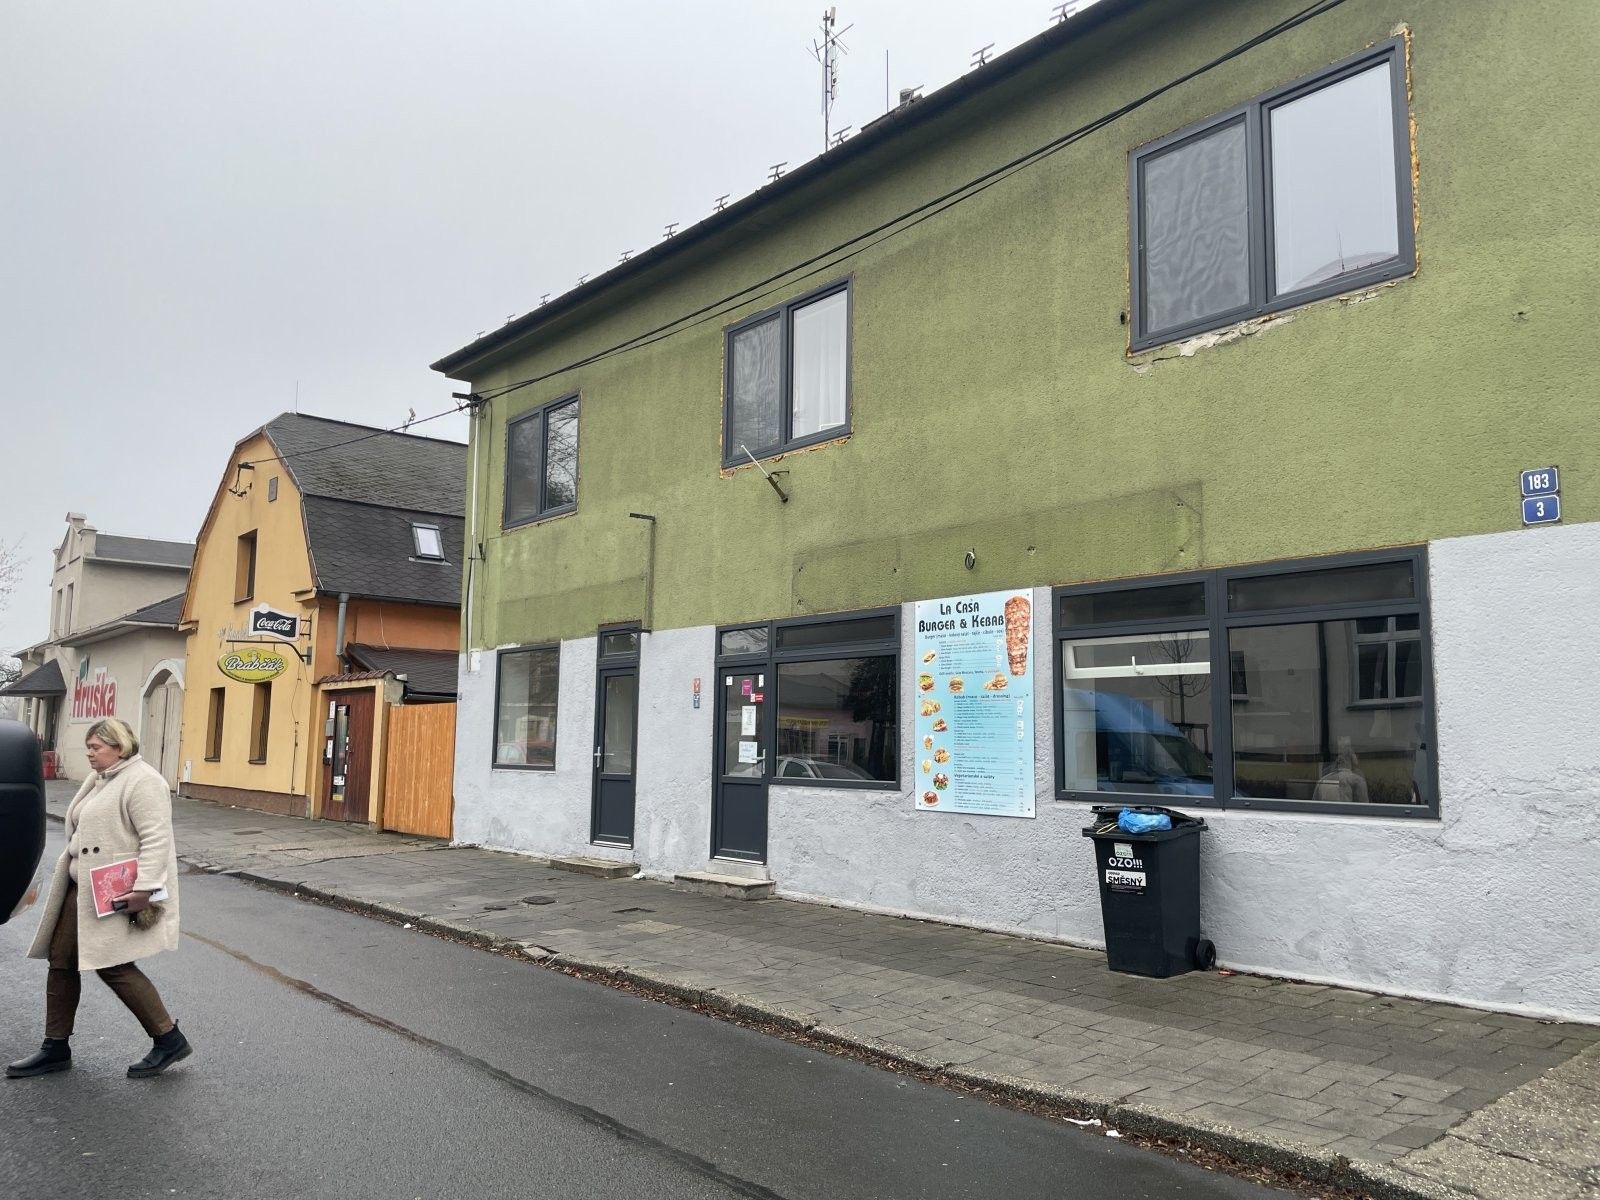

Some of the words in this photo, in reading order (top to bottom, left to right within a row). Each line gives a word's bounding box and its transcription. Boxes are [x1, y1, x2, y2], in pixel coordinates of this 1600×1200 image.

[1528, 474, 1549, 490] 183
[1536, 502, 1545, 517] 3
[960, 619, 967, 628] &
[225, 655, 284, 671] Brabčák
[73, 672, 116, 718] Hruška
[1108, 857, 1142, 868] OZO!!!
[1107, 875, 1143, 887] SMĚSNÝ
